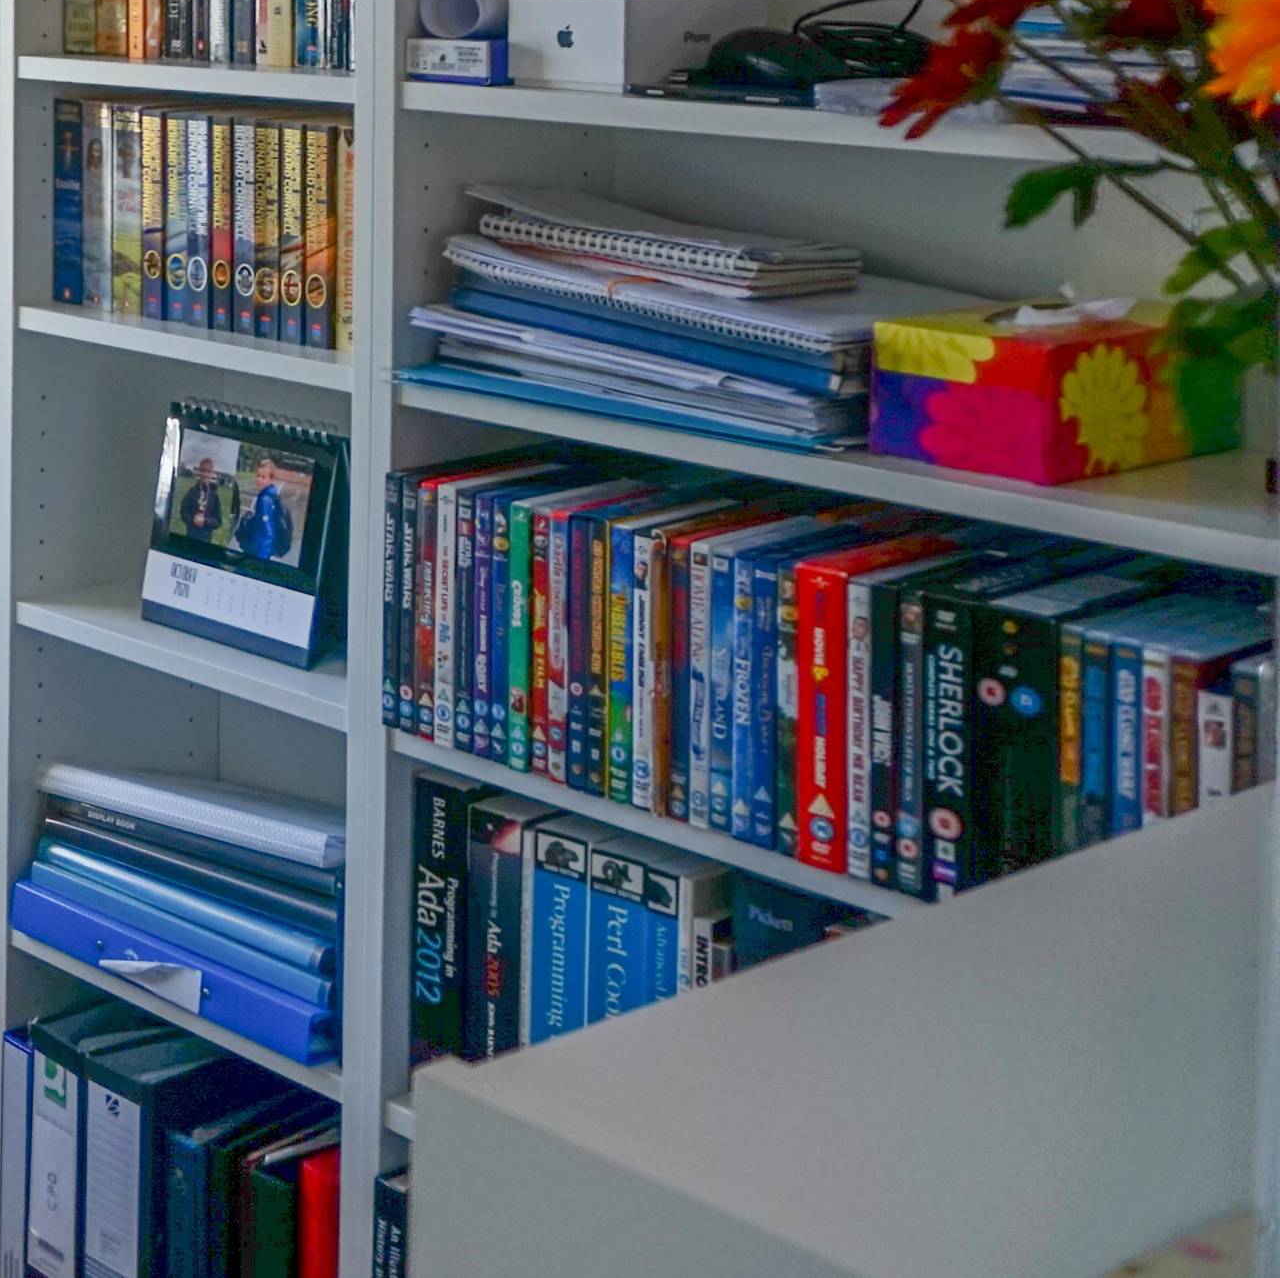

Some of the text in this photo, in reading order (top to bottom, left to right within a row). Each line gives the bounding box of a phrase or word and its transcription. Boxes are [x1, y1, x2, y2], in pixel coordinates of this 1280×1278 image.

[142, 116, 152, 226] BERNARD CORNWELL
[235, 125, 245, 240] BERNARD CORNWELL
[283, 129, 293, 179] BERNARD
[171, 562, 198, 585] OCTOBER
[173, 581, 190, 598] 2020
[384, 560, 393, 603] WARS
[403, 560, 413, 610] WARS
[440, 559, 449, 592] SECRET
[692, 565, 707, 614] HOME
[440, 594, 449, 611] LIFE
[638, 595, 647, 688] JOHNNY ENGLISH
[735, 658, 751, 726] FROZEN
[852, 656, 865, 803] HAPPY BIRTHDAY MR BEAN
[937, 644, 964, 798] SHERLOCK
[814, 736, 826, 789] HOLIDAY
[927, 759, 935, 780] TWO
[431, 797, 445, 859] BARNES
[416, 865, 444, 1004] Ada 2012
[445, 877, 459, 978] Programming in
[546, 884, 570, 1027] Programming
[605, 905, 628, 958] Perl
[487, 920, 502, 997] Ada 2005
[655, 923, 668, 991] Advanced
[696, 935, 709, 988] INTRO
